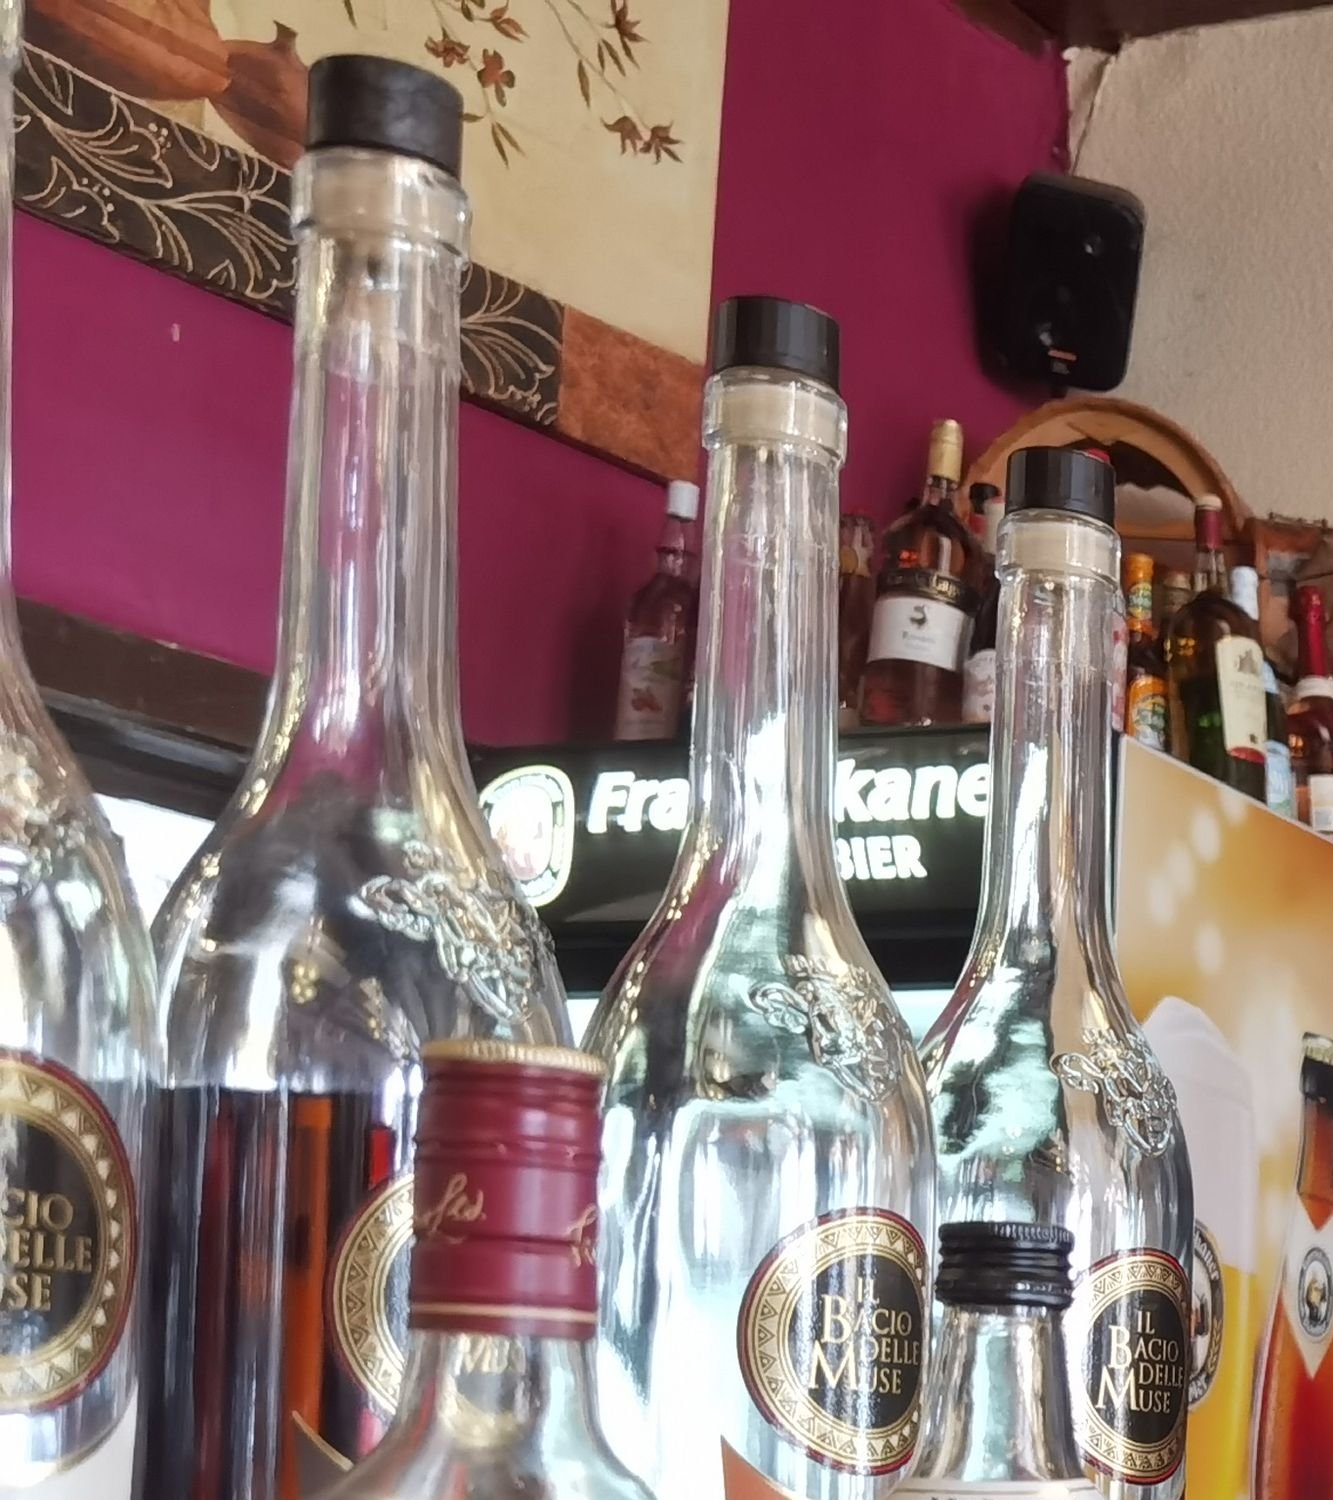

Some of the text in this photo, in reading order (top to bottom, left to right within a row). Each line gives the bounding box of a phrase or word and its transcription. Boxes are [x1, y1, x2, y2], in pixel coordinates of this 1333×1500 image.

[9, 1229, 93, 1274] ELLE
[1135, 1309, 1156, 1335] IL
[1108, 1324, 1179, 1369] BACIO
[1094, 1363, 1172, 1414] MUSE
